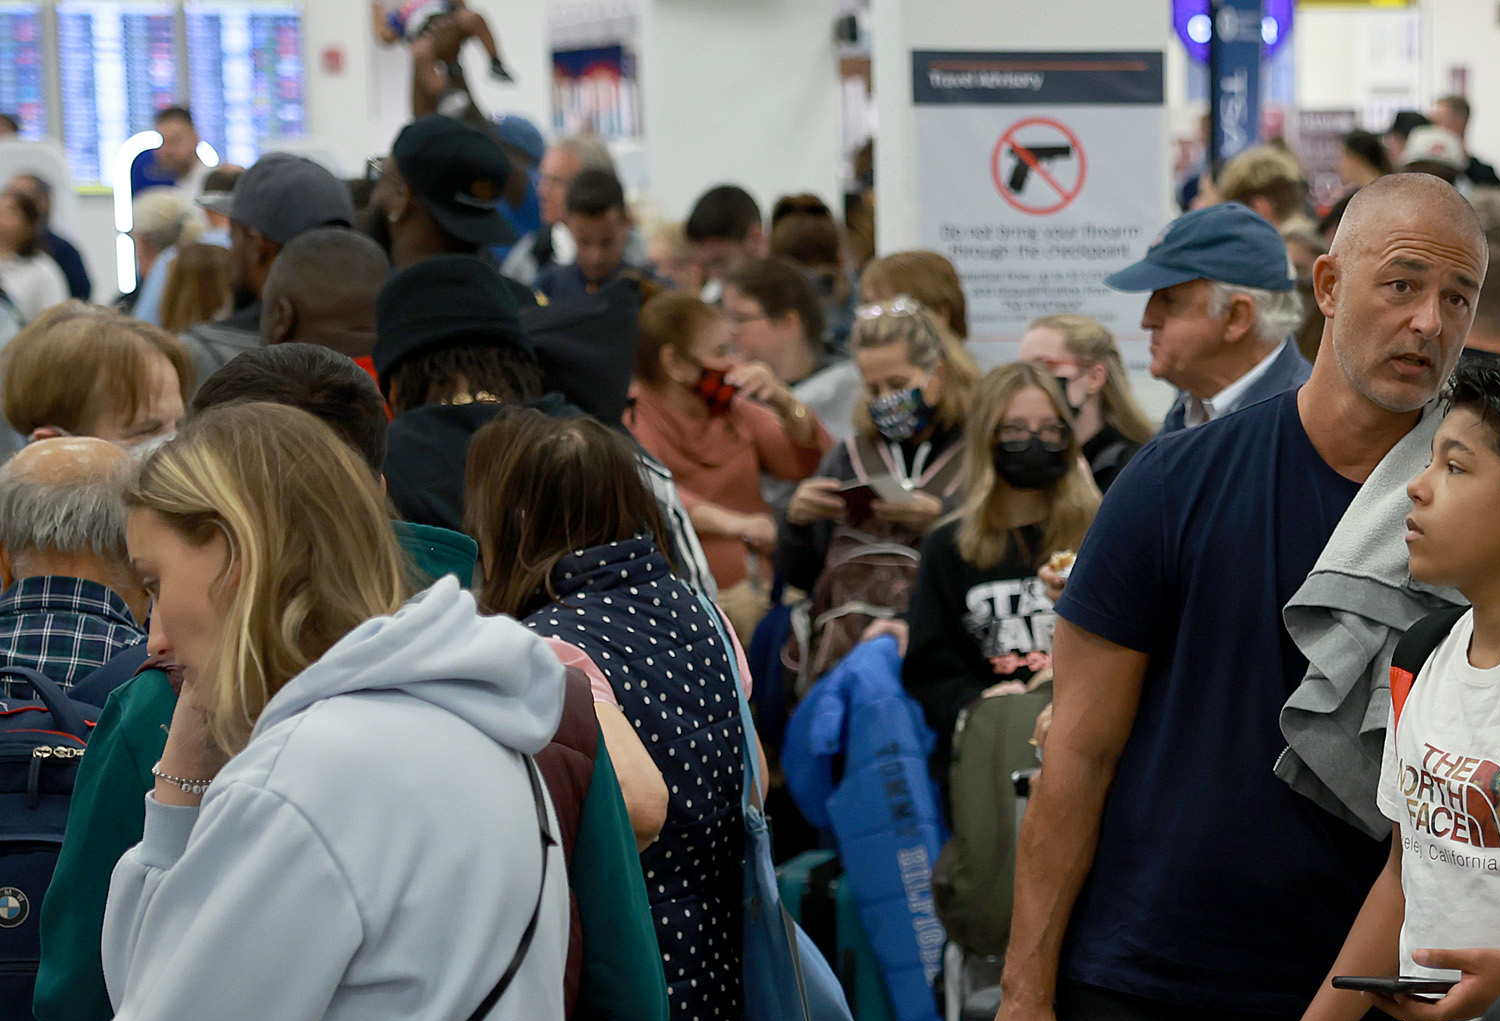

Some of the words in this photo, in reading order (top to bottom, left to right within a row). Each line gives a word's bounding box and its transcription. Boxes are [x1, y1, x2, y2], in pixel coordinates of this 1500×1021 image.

[965, 578, 1057, 620] STA
[1422, 743, 1481, 782] THE
[1406, 798, 1470, 844] FACE
[1428, 844, 1499, 871] California
